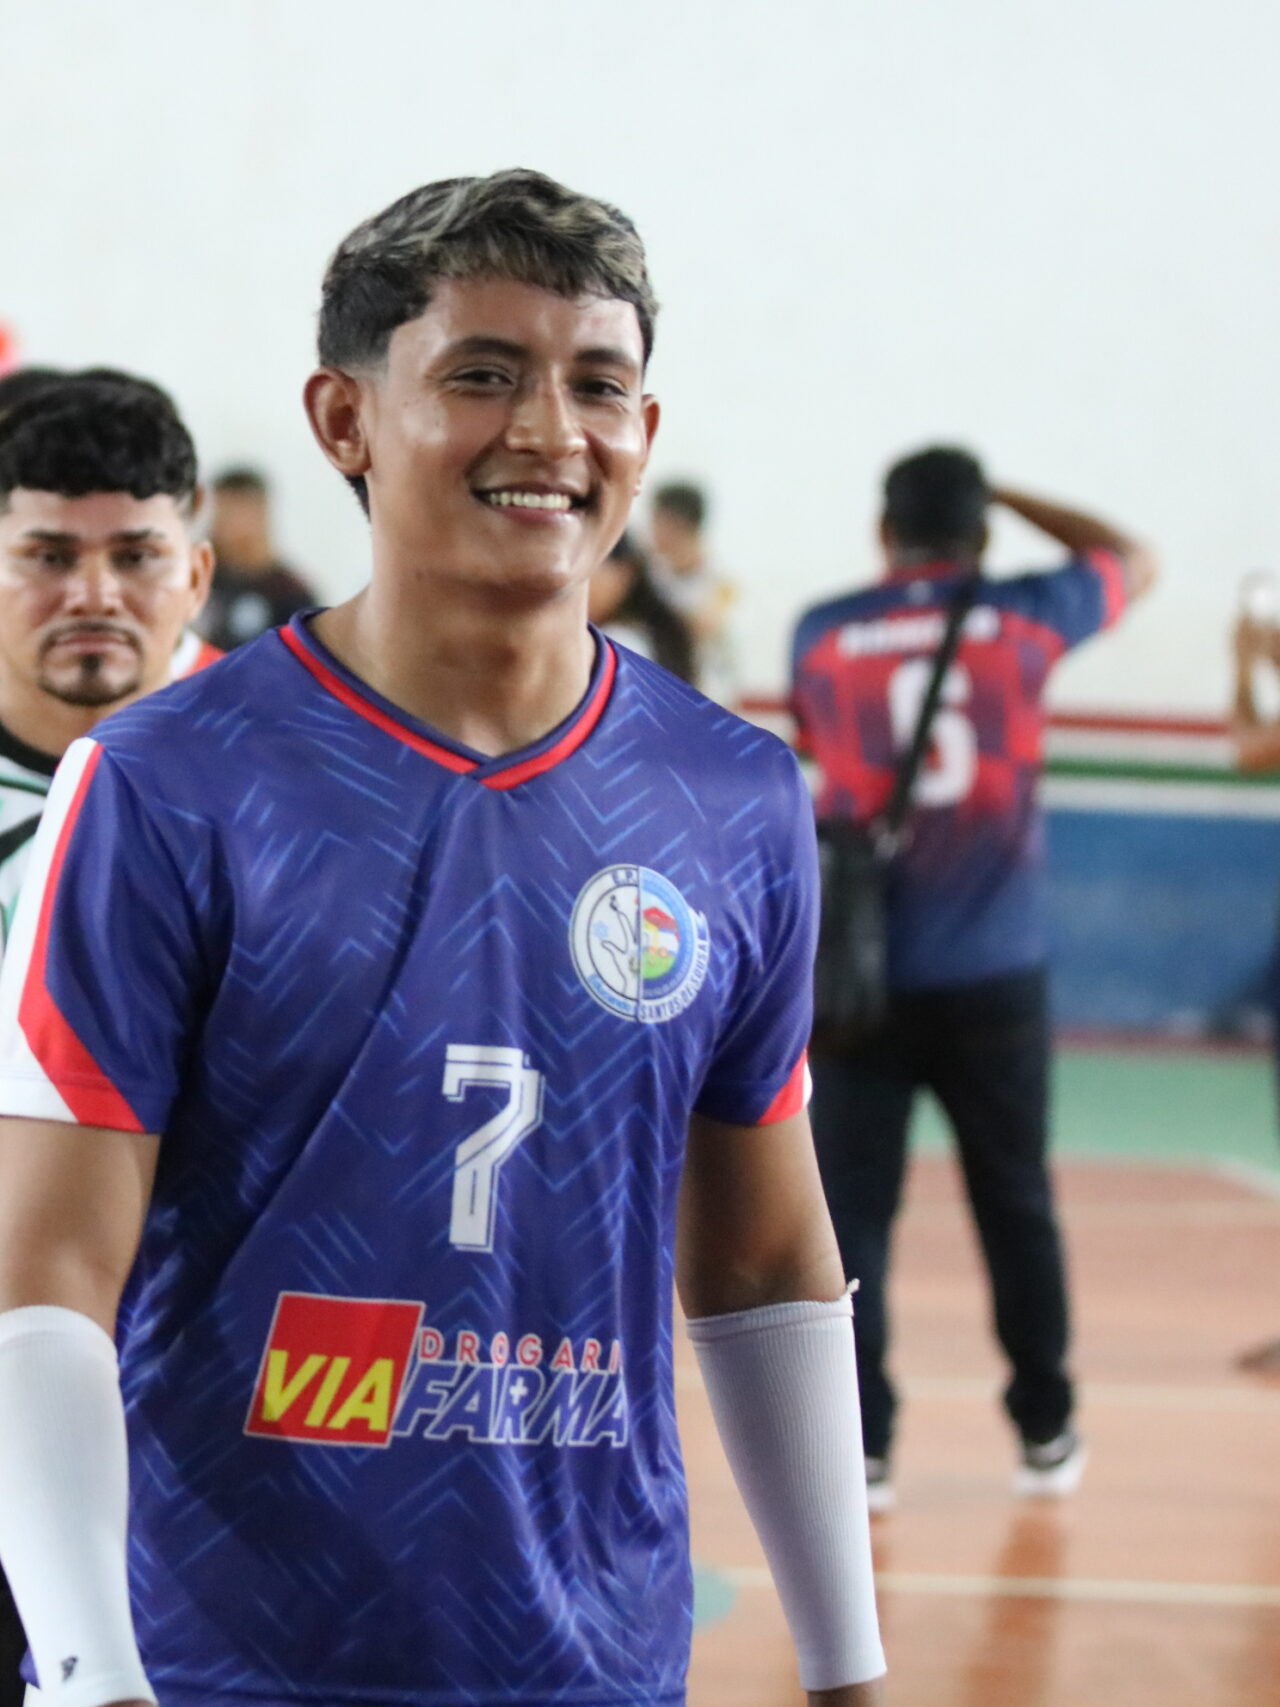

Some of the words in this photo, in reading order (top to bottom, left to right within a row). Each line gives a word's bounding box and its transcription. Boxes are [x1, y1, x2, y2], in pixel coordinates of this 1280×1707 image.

[442, 1043, 546, 1254] 7
[261, 1348, 395, 1432] VIA
[390, 1361, 629, 1448] FARMA
